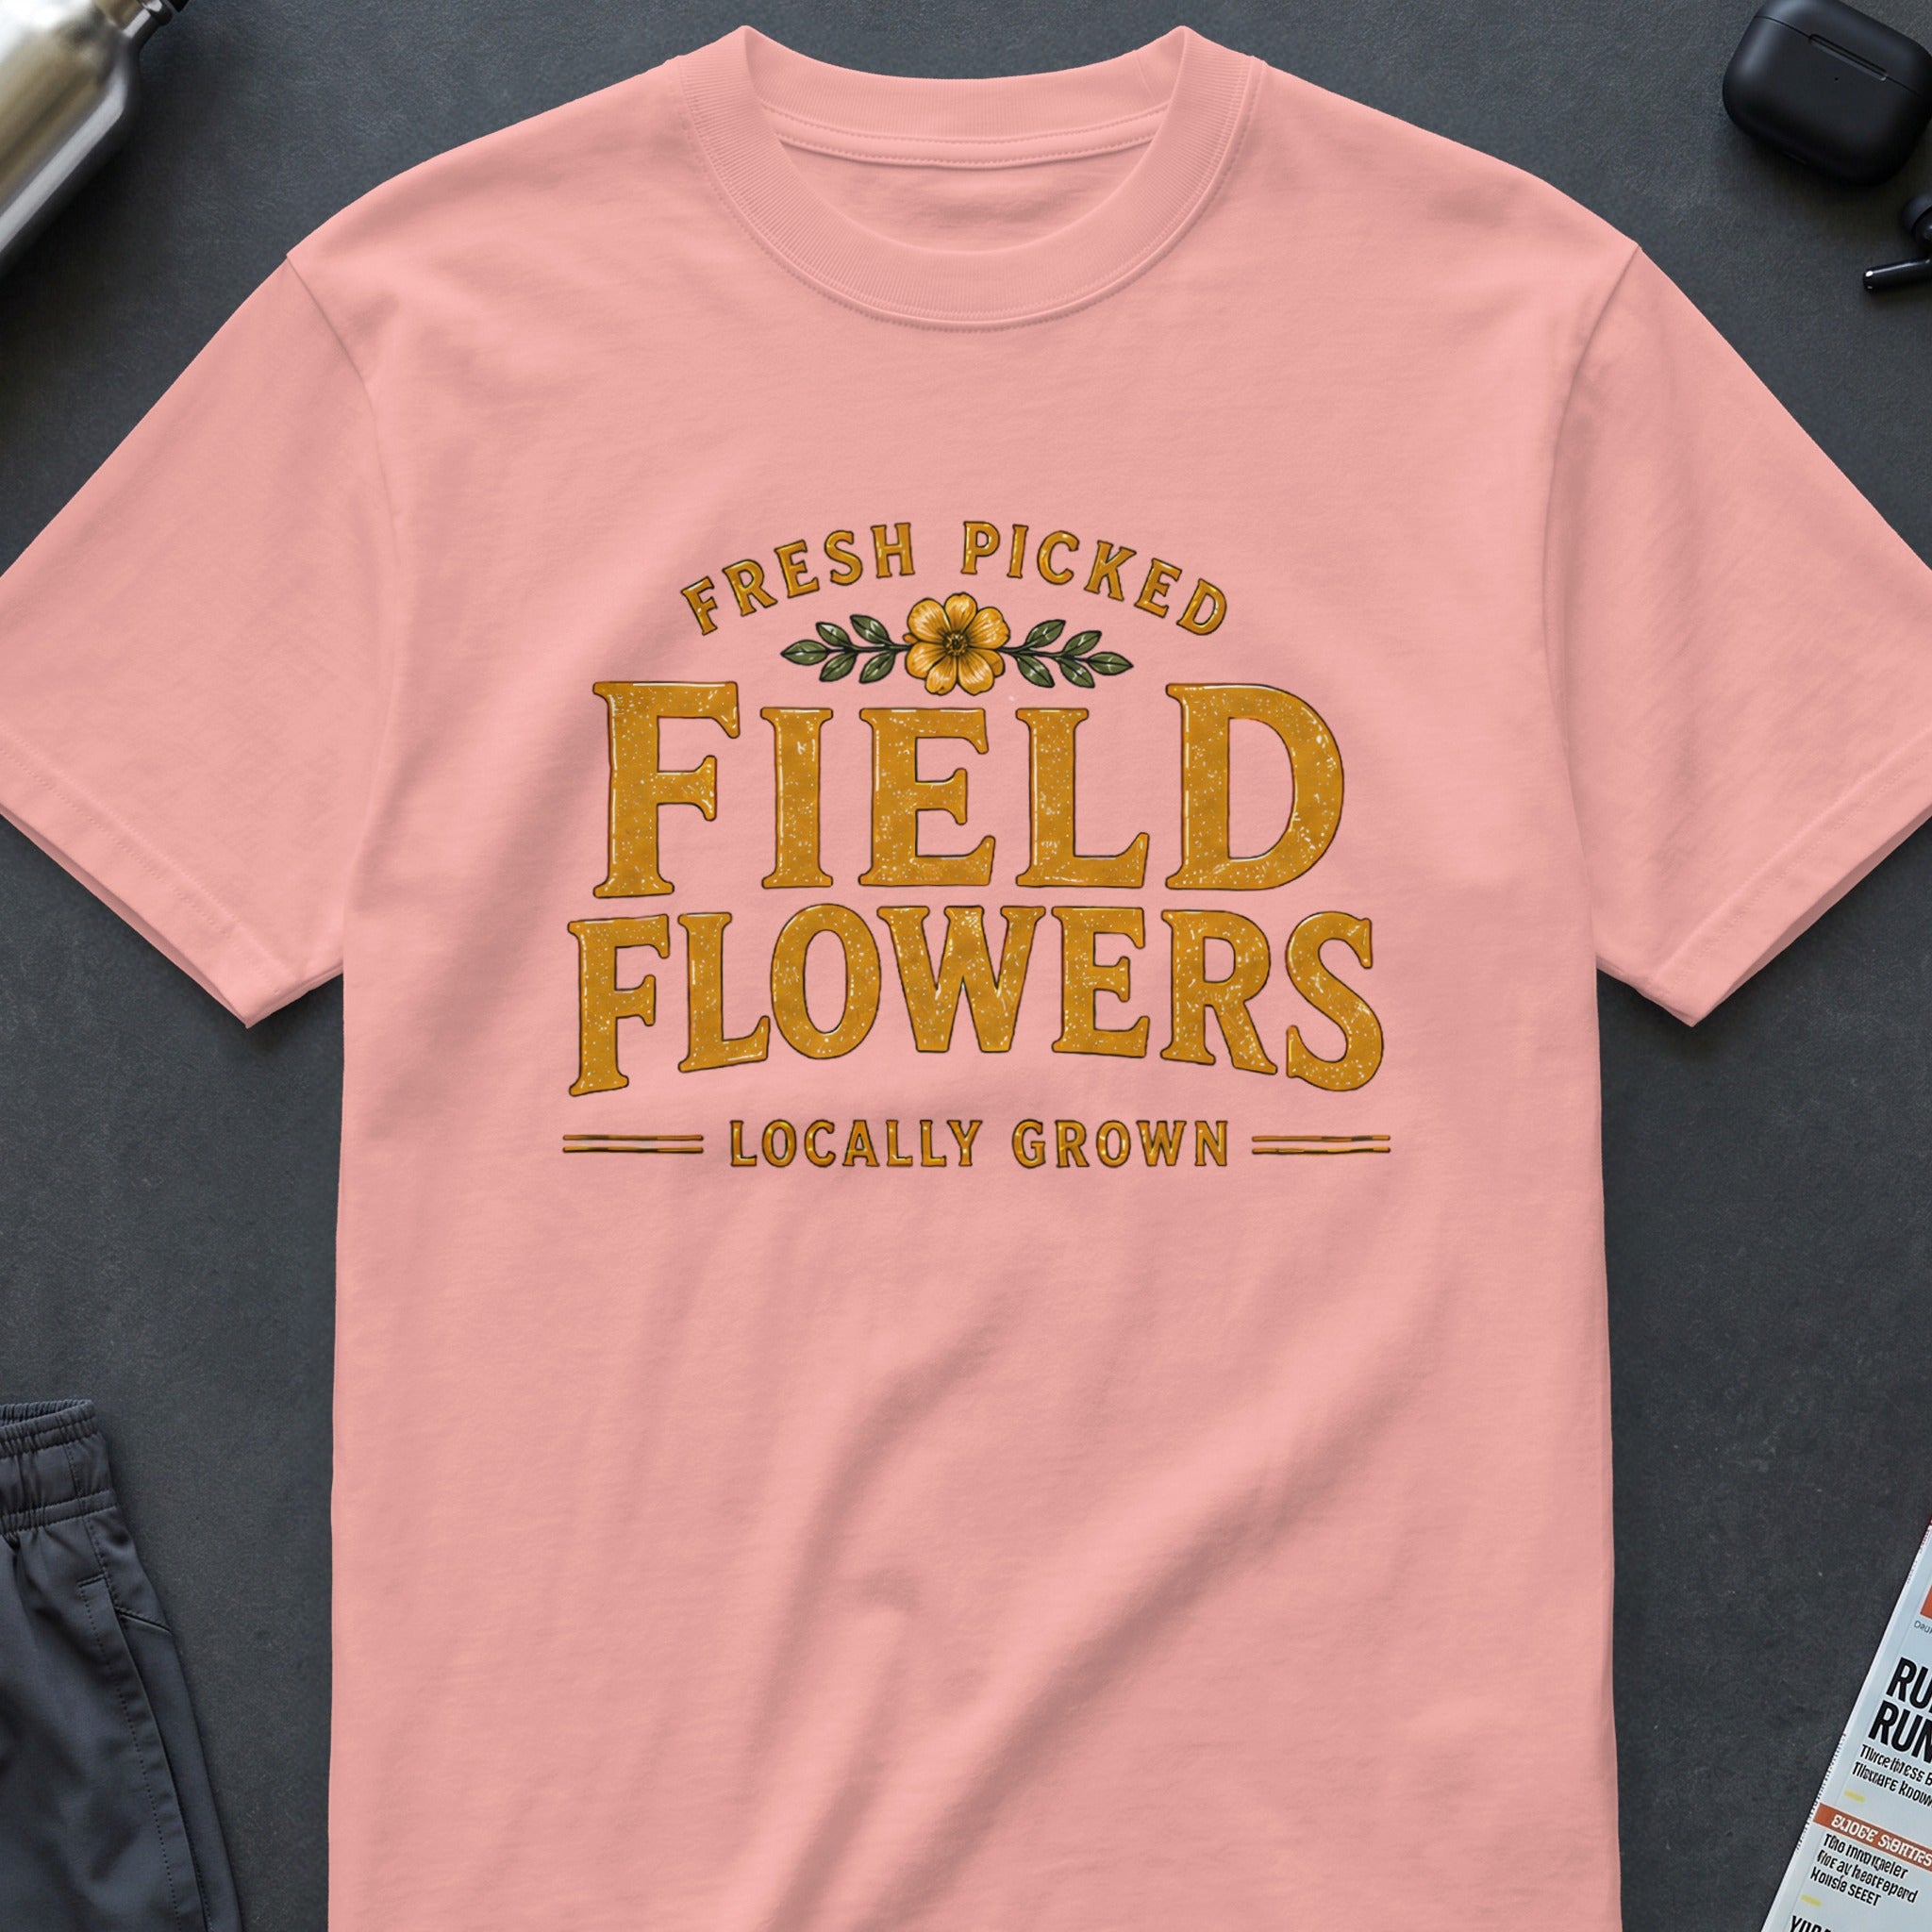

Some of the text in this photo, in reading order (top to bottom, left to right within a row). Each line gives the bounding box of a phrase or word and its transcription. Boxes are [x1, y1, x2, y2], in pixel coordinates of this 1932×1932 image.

[680, 520, 1228, 637] FRESH PICKED
[592, 681, 1345, 899] FIELD
[567, 903, 1385, 1098] FLOWERS
[730, 1119, 1228, 1169] LOCALLY GROWN
[1886, 1657, 1932, 1714] RU
